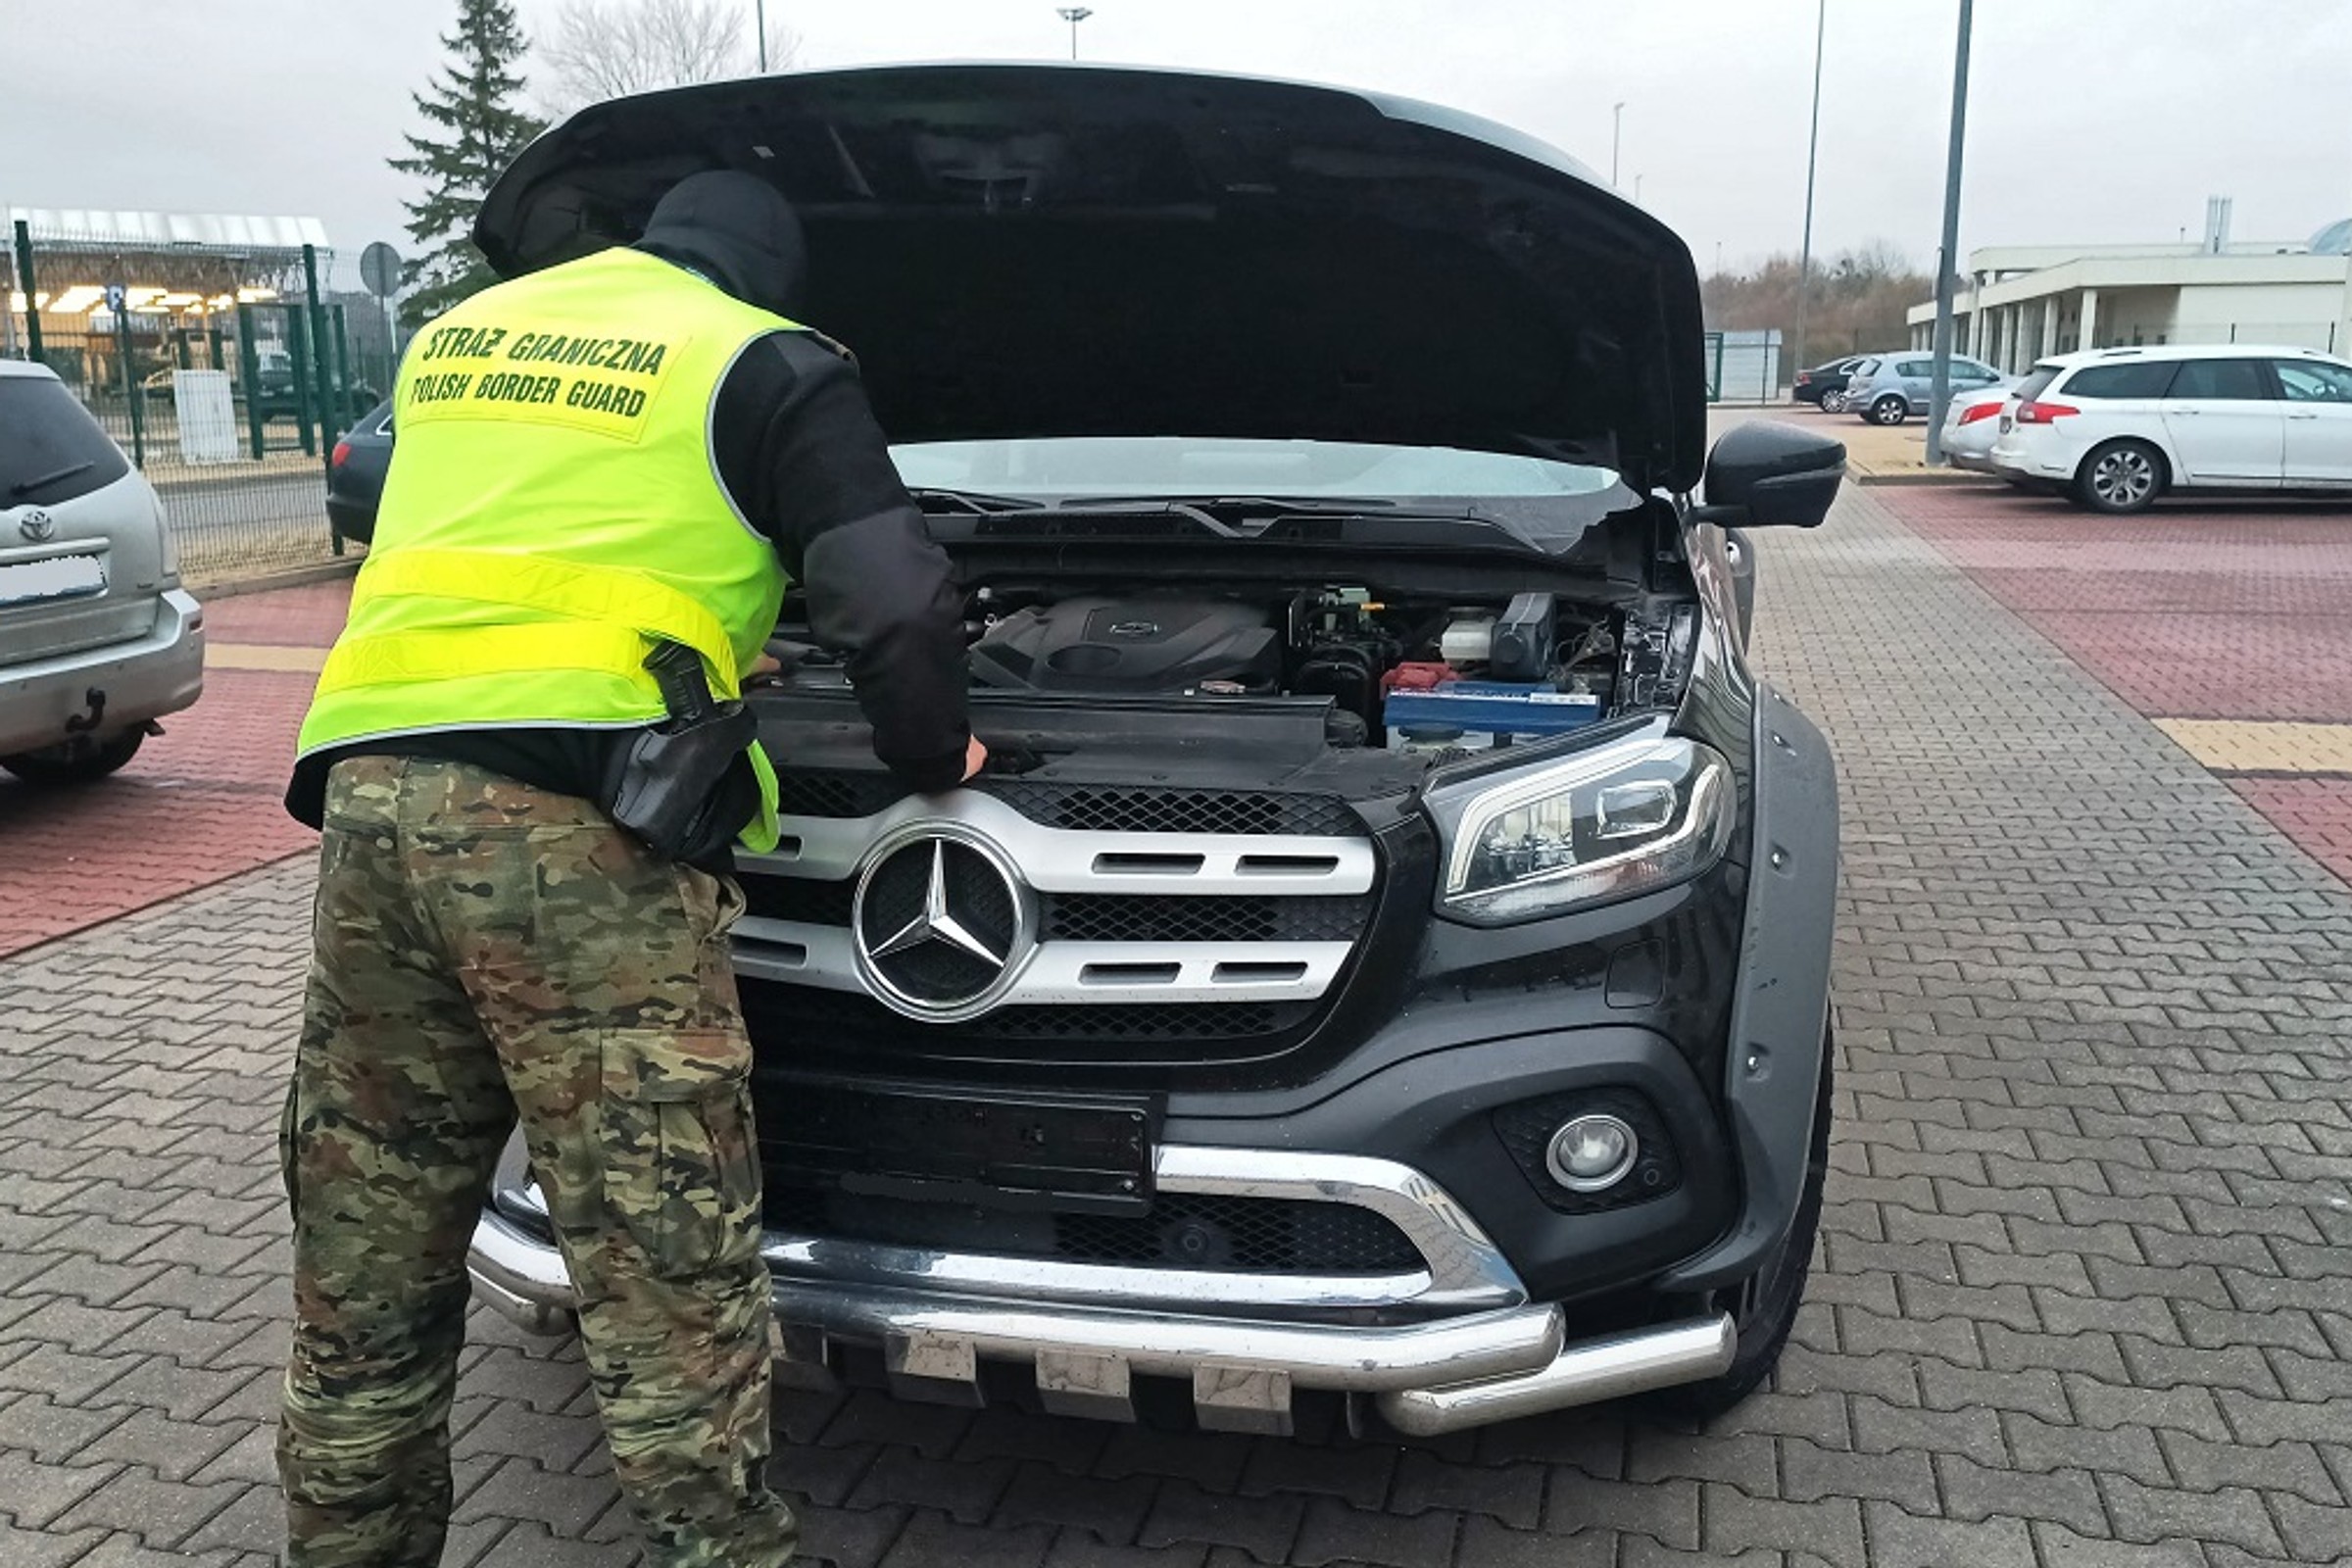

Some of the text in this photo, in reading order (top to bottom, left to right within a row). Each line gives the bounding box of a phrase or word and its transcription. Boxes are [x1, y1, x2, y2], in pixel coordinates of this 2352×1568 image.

[422, 327, 666, 375] STRAŻ GRANICZNA
[410, 372, 647, 417] POLISH BORDER GUARD
